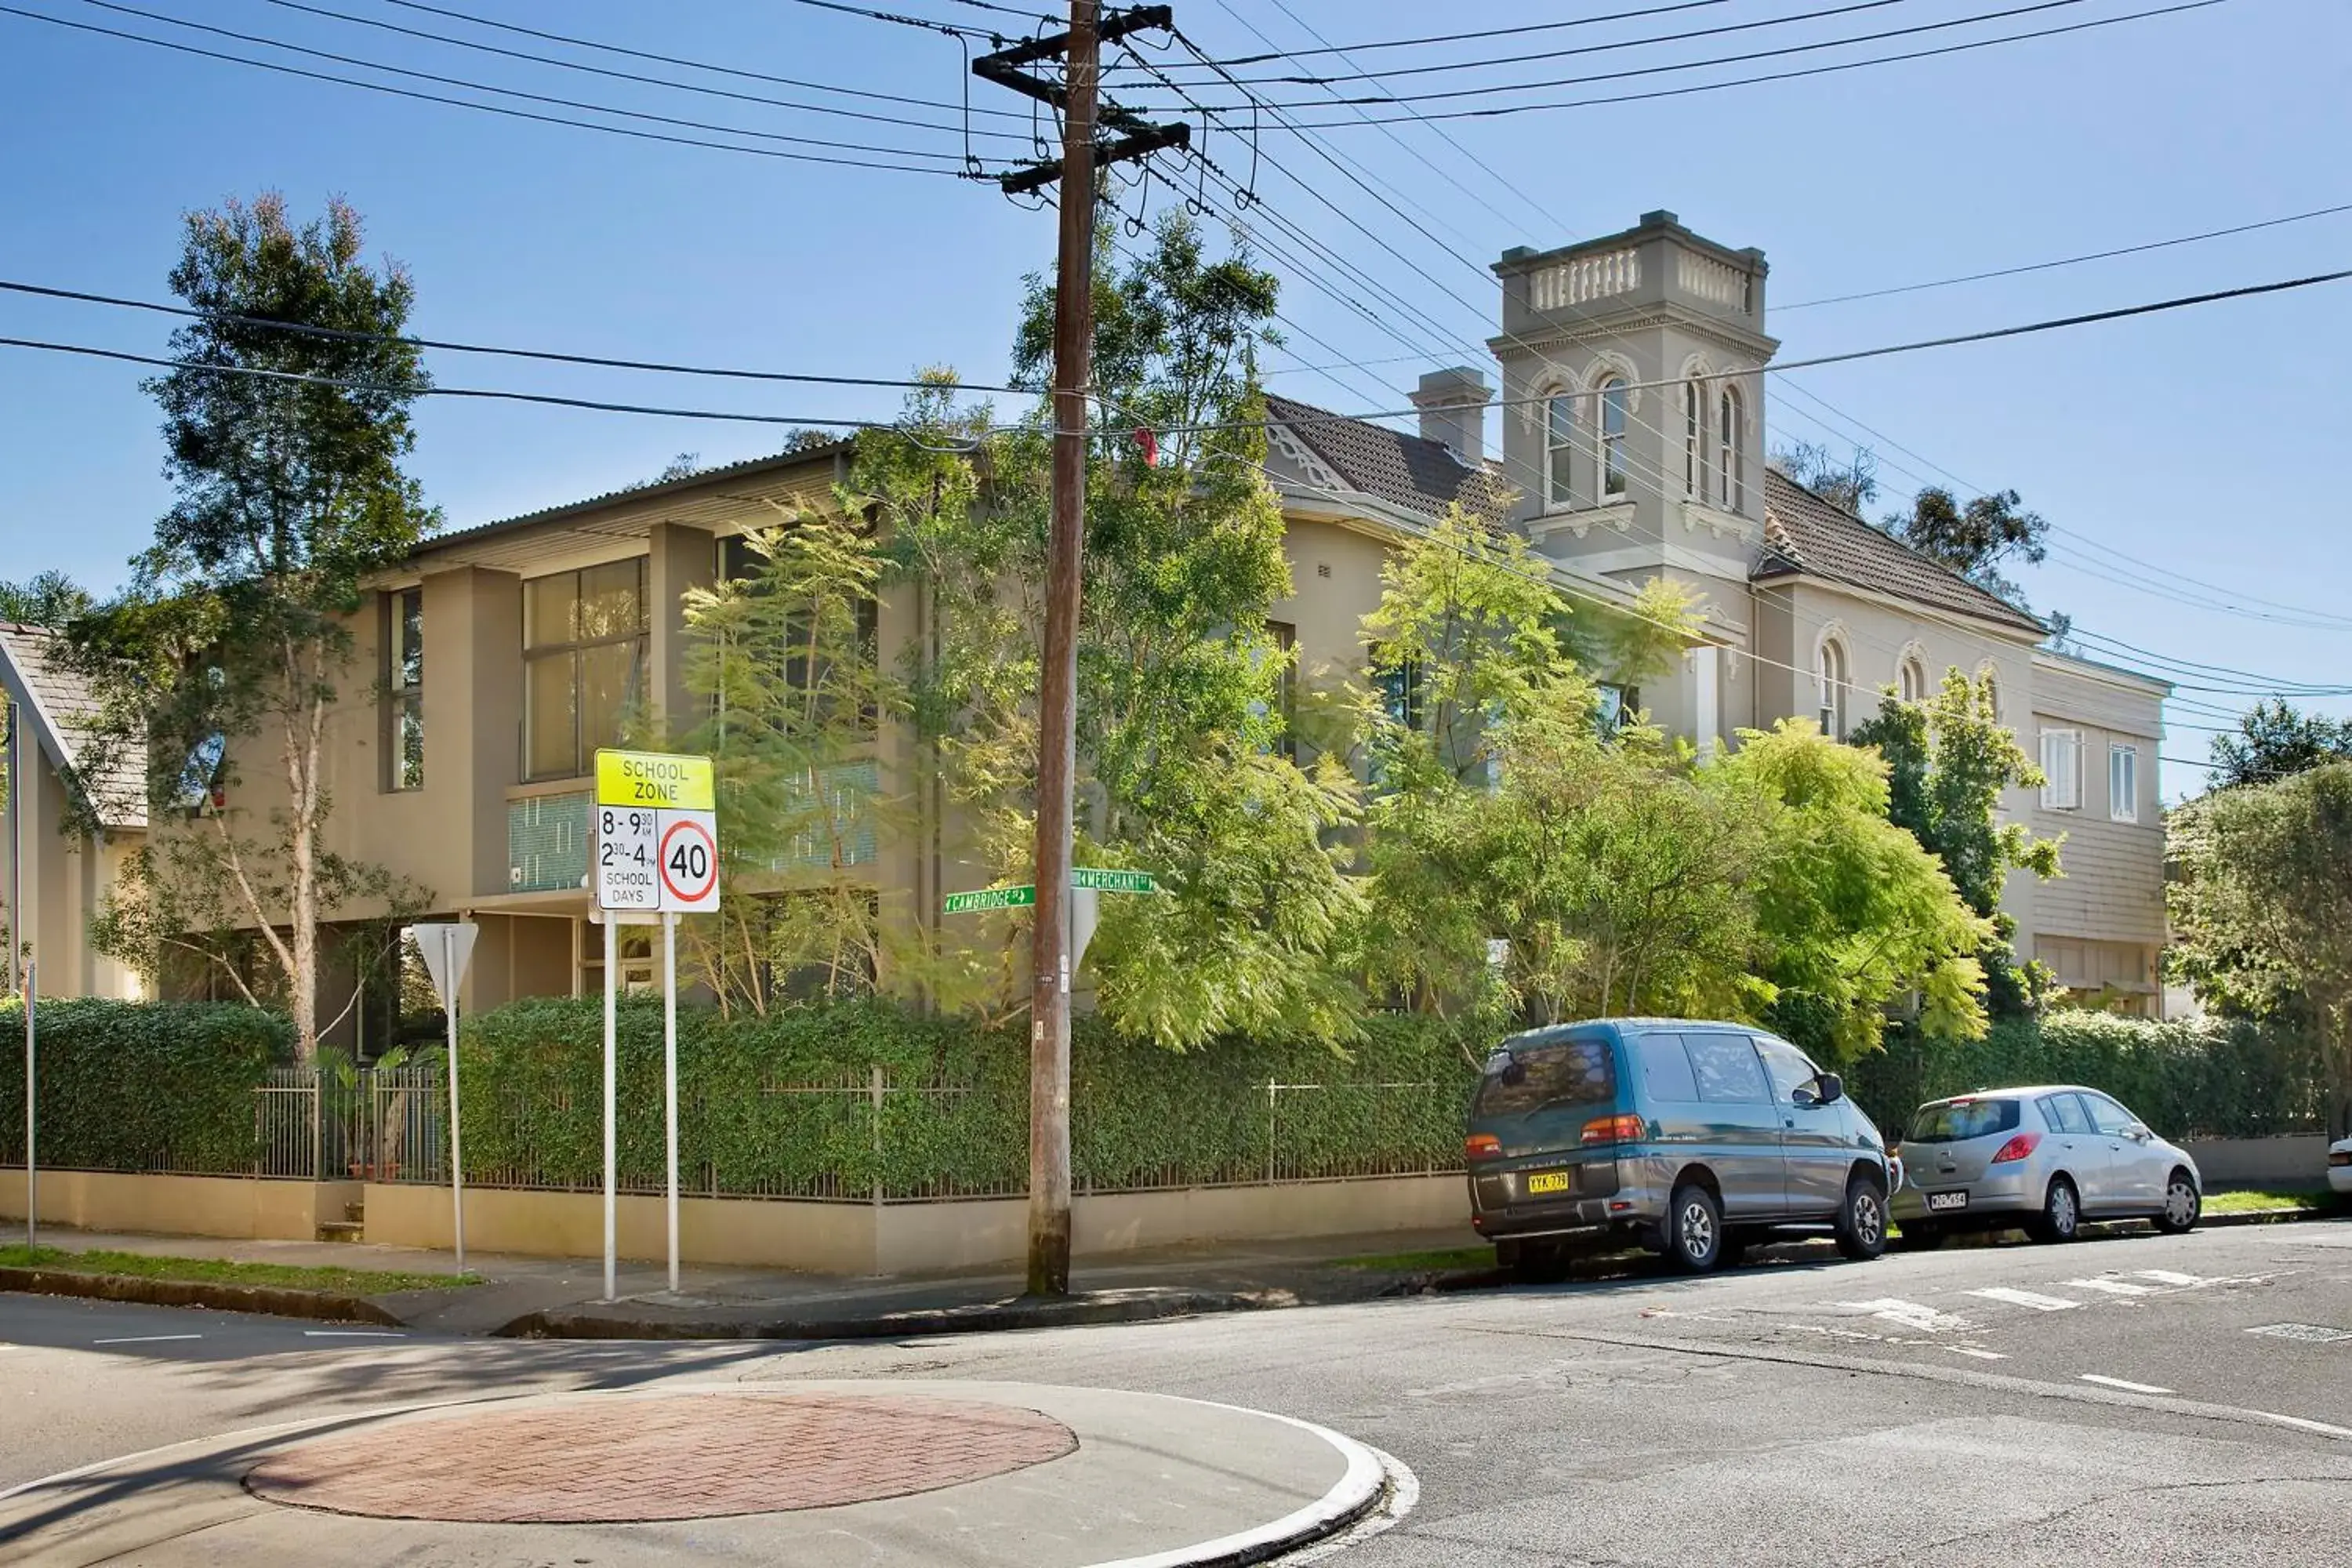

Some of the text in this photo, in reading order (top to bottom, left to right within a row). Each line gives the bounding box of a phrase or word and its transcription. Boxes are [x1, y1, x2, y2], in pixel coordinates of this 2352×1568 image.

[623, 760, 689, 781] SCHOOL
[634, 782, 678, 800] ZONE
[670, 844, 706, 879] 40
[606, 873, 653, 886] SCHOOL
[1087, 872, 1140, 891] MERCHANT
[612, 890, 644, 902] DAYS
[953, 890, 1011, 911] CAMBRIDGE
